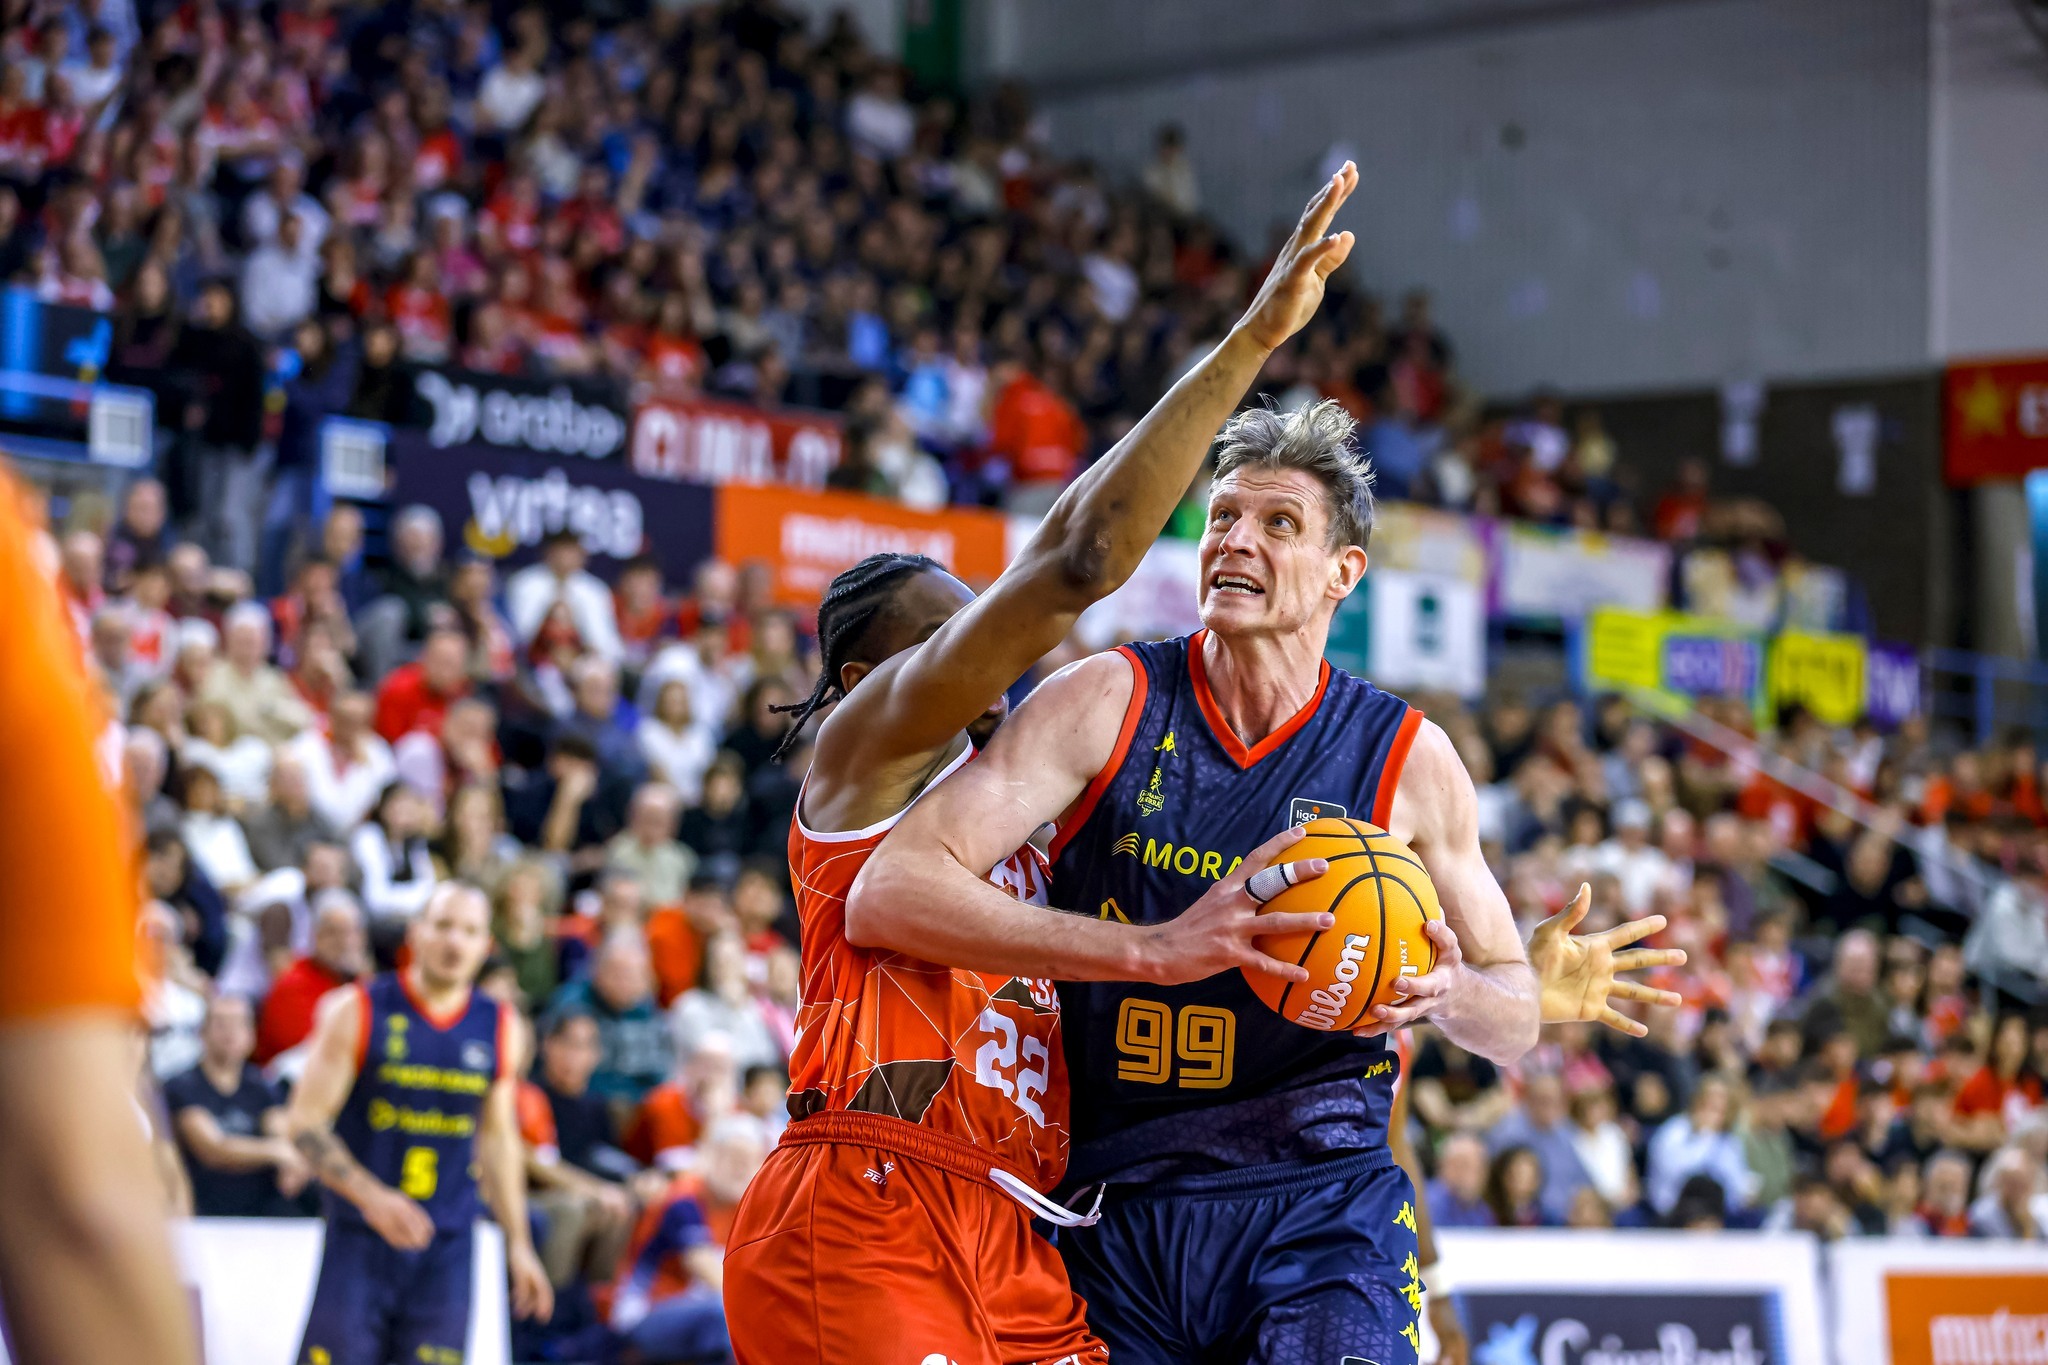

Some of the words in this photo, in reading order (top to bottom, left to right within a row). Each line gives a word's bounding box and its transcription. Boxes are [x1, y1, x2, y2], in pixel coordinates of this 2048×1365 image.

[1296, 809, 1318, 821] liga
[1399, 938, 1408, 964] NXT
[975, 1007, 1050, 1129] 22
[1115, 997, 1237, 1090] 99
